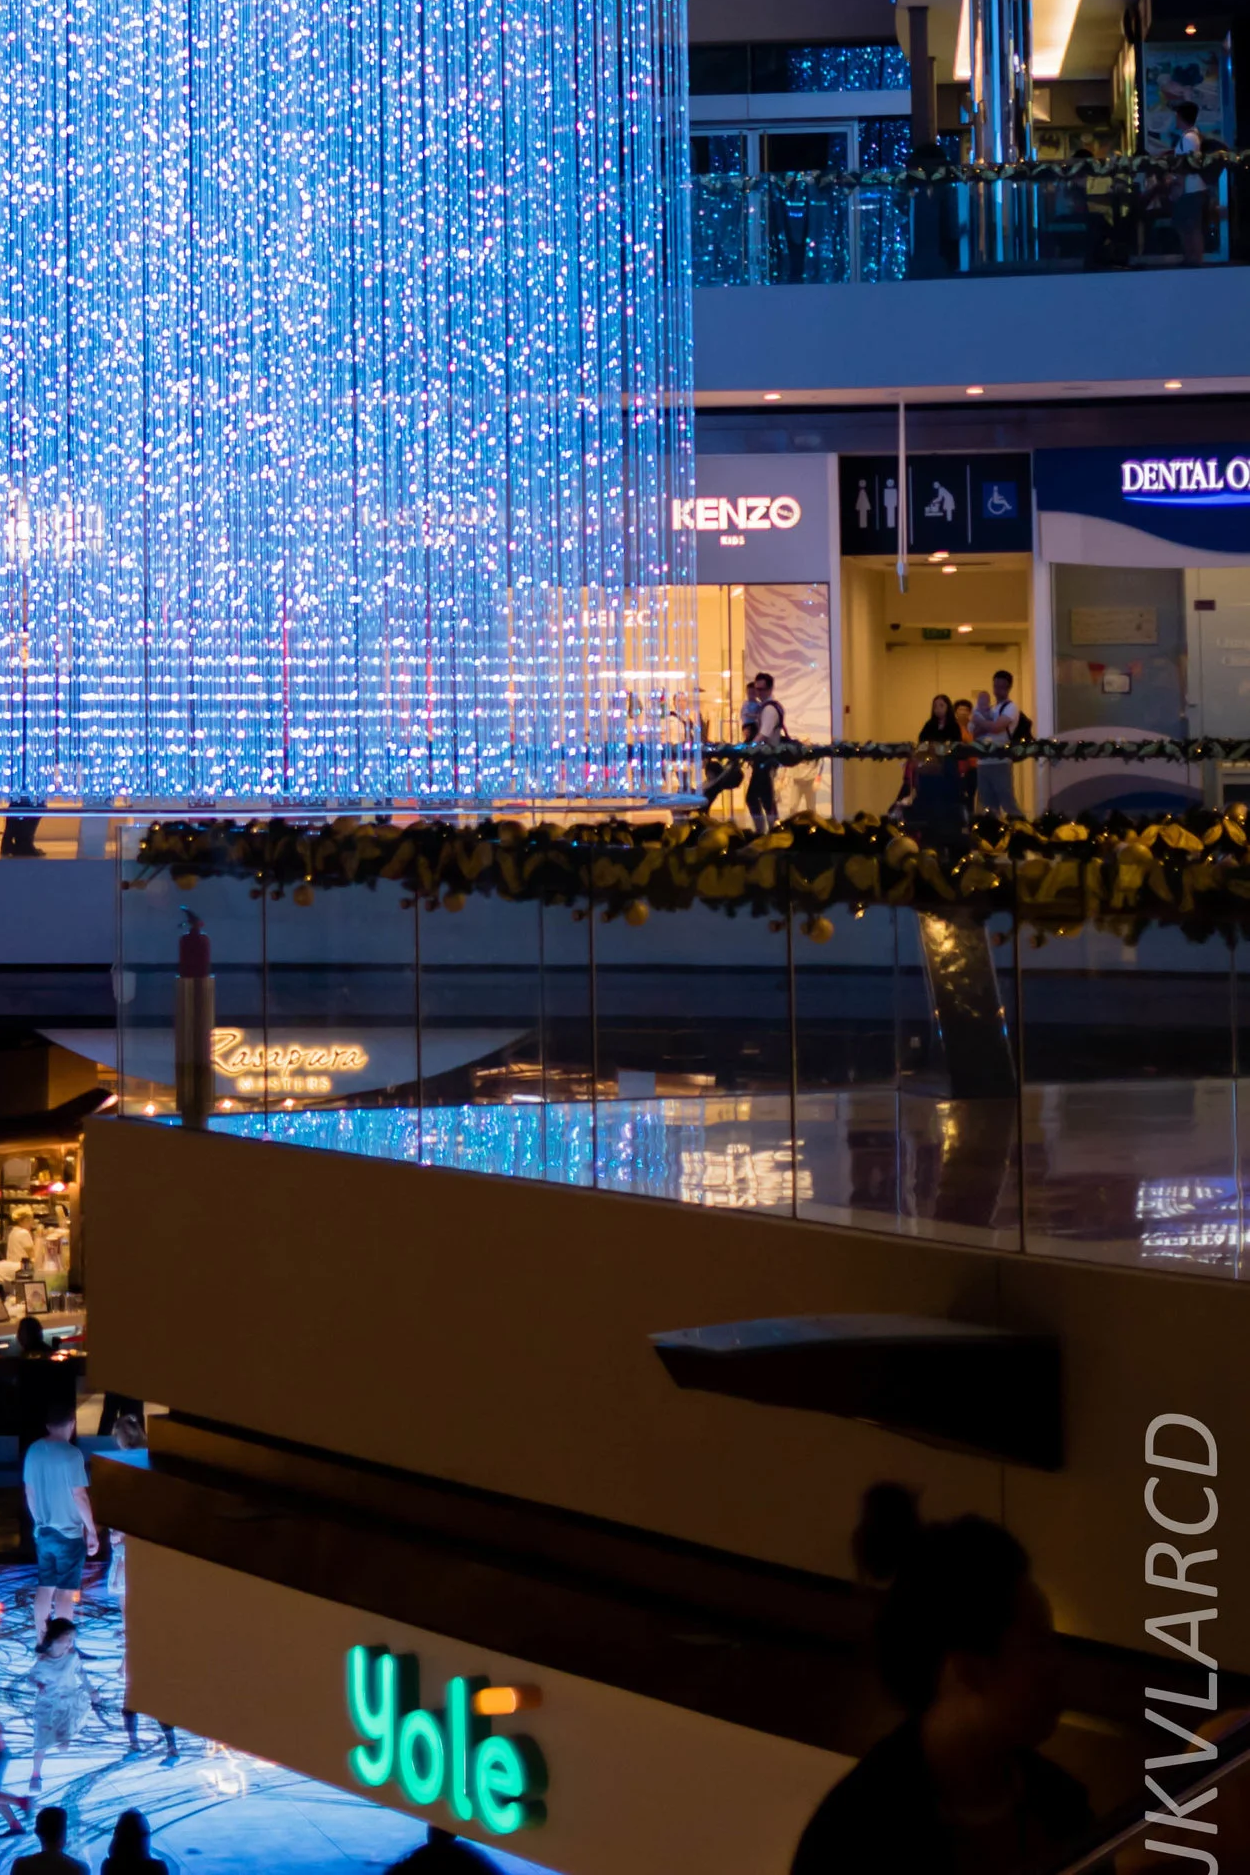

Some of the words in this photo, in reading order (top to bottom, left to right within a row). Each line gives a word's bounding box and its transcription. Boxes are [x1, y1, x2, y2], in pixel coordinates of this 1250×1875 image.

[1121, 458, 1225, 491] DENTAL
[1225, 456, 1250, 491] O
[671, 496, 802, 530] KENZO
[719, 534, 746, 547] KIDS
[211, 1027, 369, 1077] Rasapura
